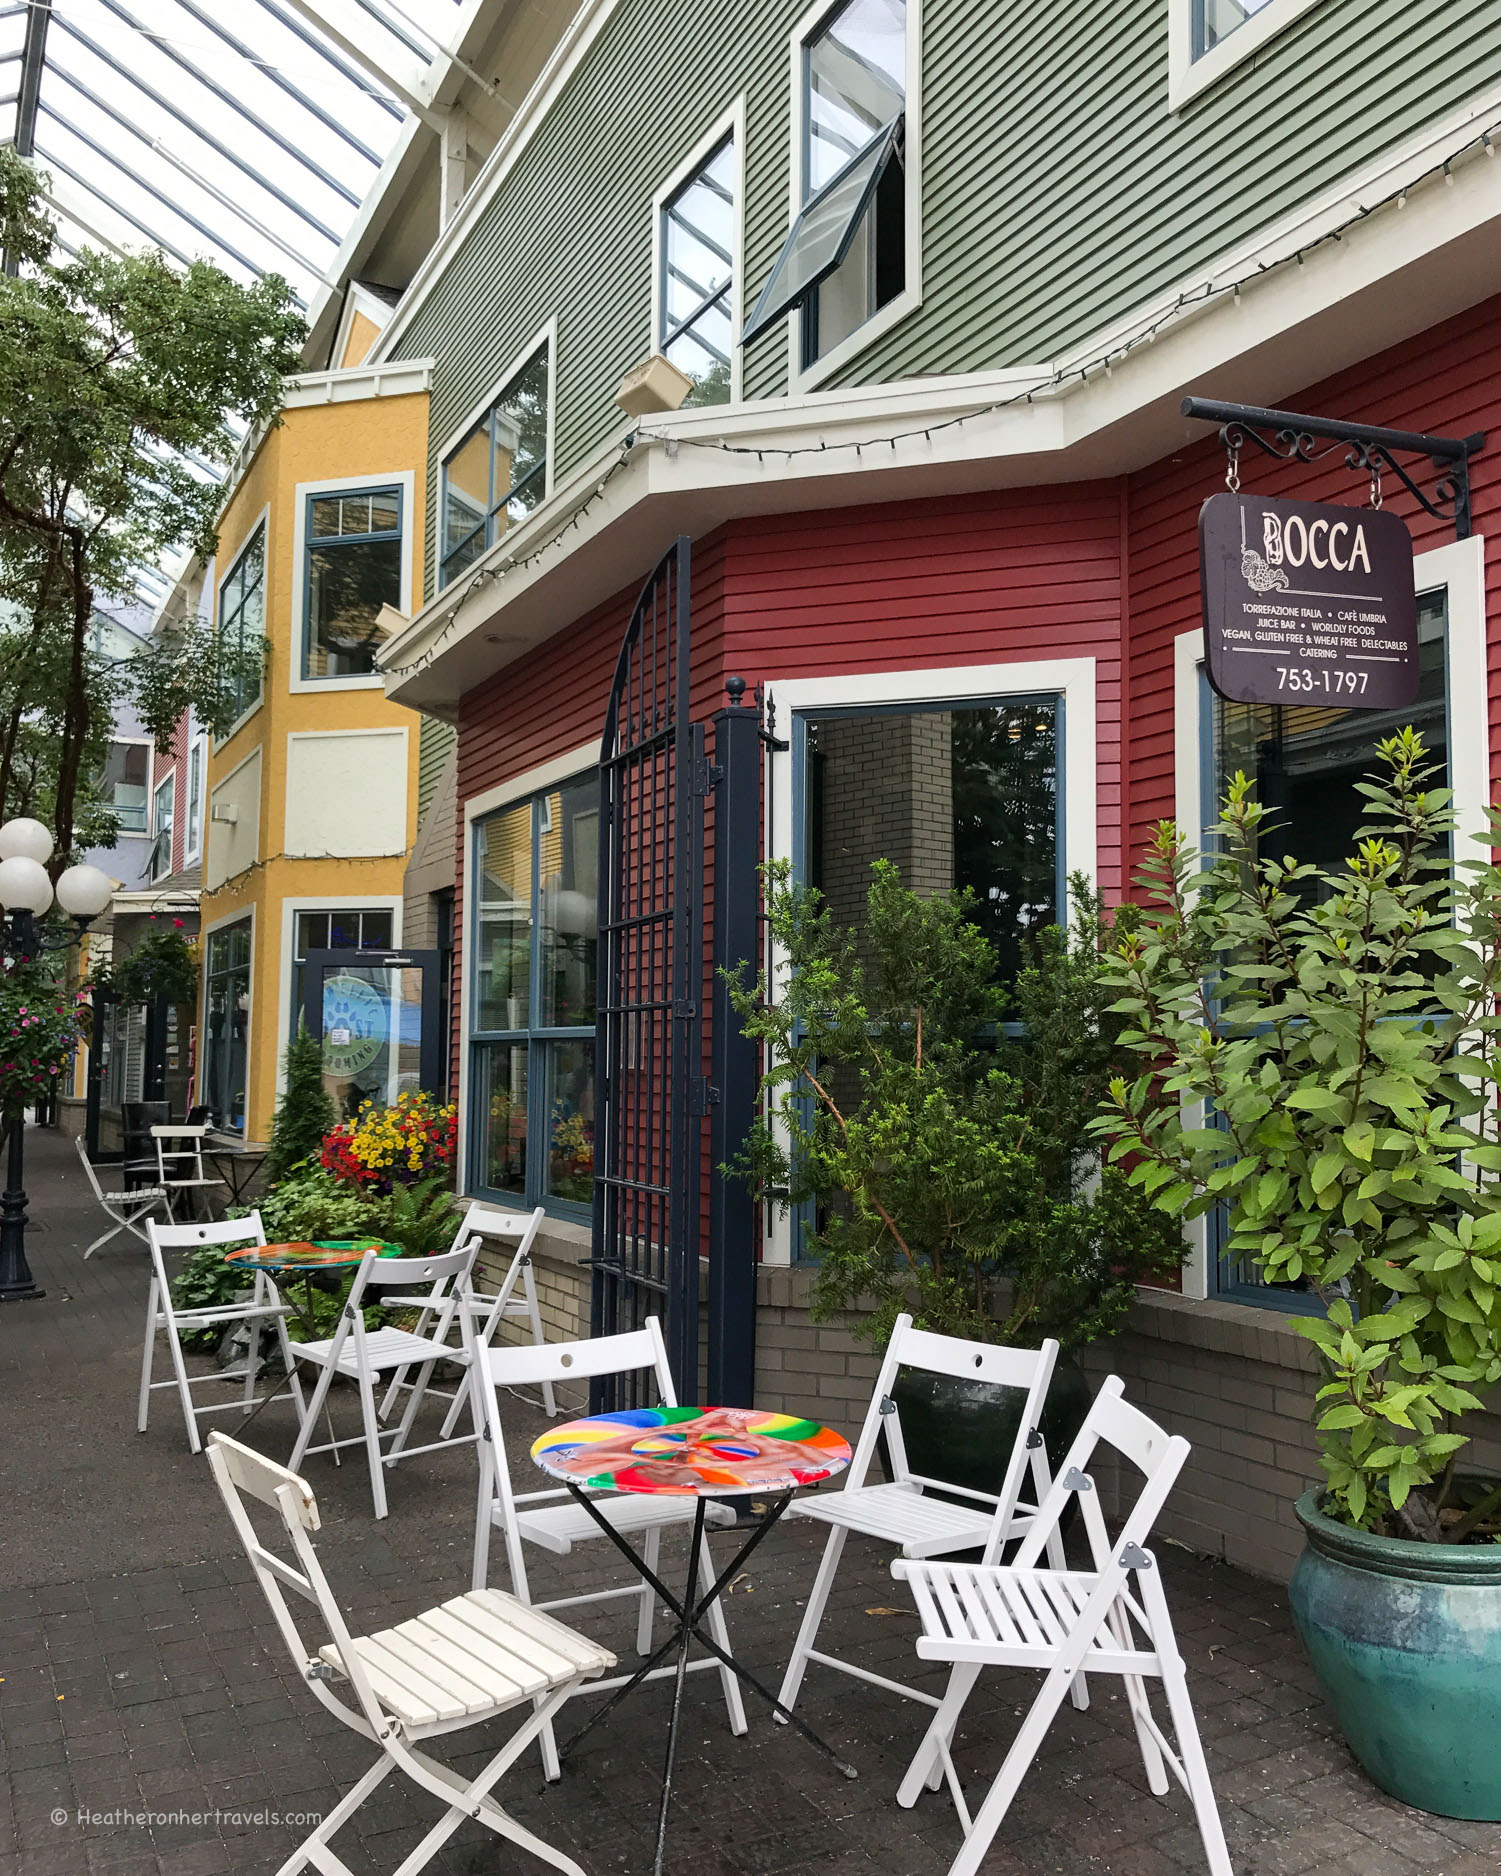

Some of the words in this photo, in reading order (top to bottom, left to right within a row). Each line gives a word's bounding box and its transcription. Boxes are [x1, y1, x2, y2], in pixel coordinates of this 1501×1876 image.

[1262, 511, 1371, 574] BOCCA
[1242, 603, 1299, 617] TORREFAZIONE
[1301, 608, 1322, 618] ITALIA
[1359, 613, 1387, 623] UMBRIA
[1257, 618, 1279, 628] JUICE
[1281, 620, 1296, 629] BAR
[1312, 622, 1347, 633] WORLDLY
[1349, 625, 1375, 636] FOODS
[1222, 629, 1253, 641] VEGAN,
[1255, 631, 1284, 642] GLUTEN
[1286, 633, 1304, 643] FREE
[1306, 635, 1312, 644] &
[1314, 636, 1338, 646] WHEAT
[1340, 637, 1358, 648] FREE
[1362, 639, 1408, 651] DELECTABLES
[1299, 648, 1337, 659] CATERING
[1276, 667, 1368, 694] 753-1797
